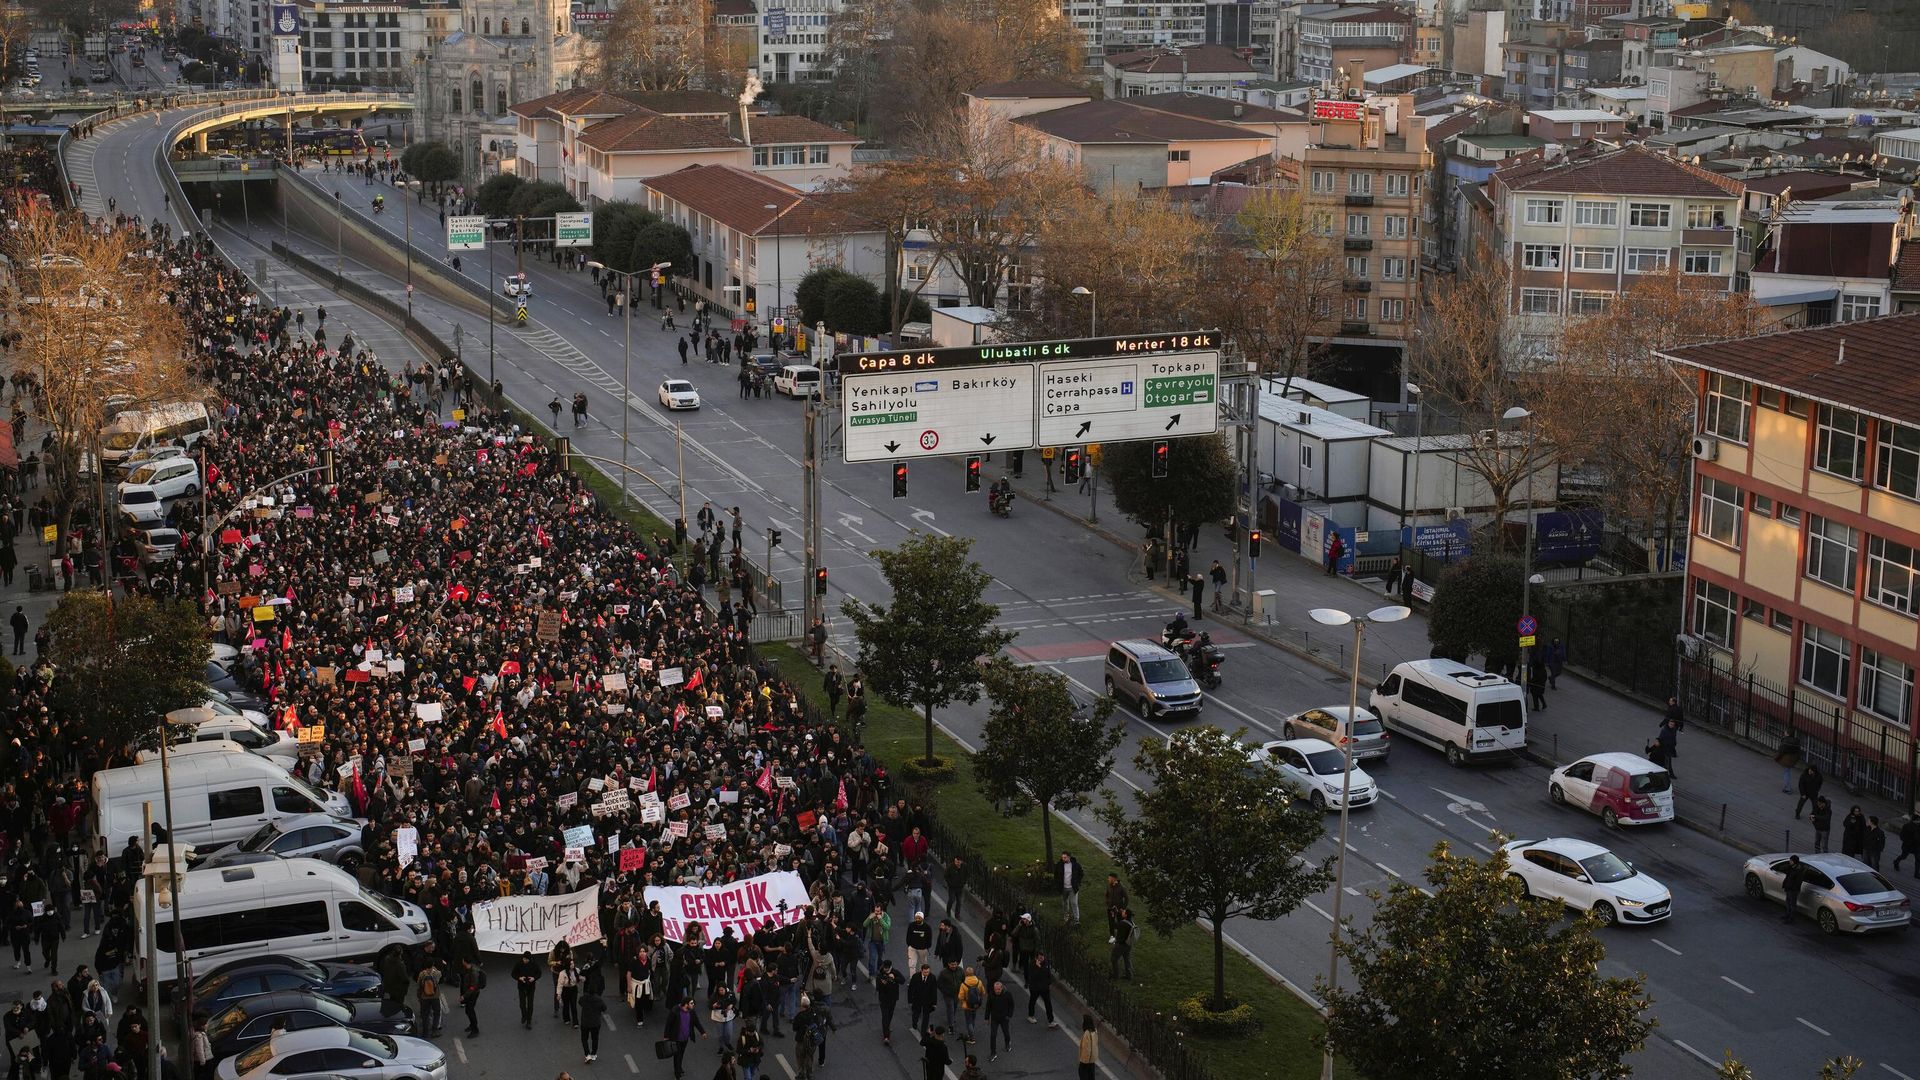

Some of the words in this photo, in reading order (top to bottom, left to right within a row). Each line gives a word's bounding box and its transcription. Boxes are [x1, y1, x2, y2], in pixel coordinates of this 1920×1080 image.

[1317, 107, 1360, 119] HOTEL
[1116, 338, 1165, 352] Merter
[1171, 337, 1188, 348] 18
[1193, 335, 1211, 346] dk
[981, 346, 1037, 359] Ulubatlı
[1041, 345, 1050, 355] 6
[1054, 344, 1071, 354] dk
[859, 357, 897, 370] Çapa
[902, 354, 911, 366] 8
[917, 353, 935, 364] dk
[1152, 362, 1205, 375] Topkapı
[952, 377, 1017, 390] Bakırköy
[1047, 373, 1093, 385] Haseki
[1145, 376, 1214, 391] Çevreyolu
[852, 385, 913, 397] Yenikapı
[1047, 386, 1118, 400] Cerrahpaşa
[851, 398, 917, 412] Sahilyolu
[1145, 393, 1191, 404] Otogar
[1047, 403, 1080, 414] Çapa
[851, 415, 886, 425] Avrasya
[888, 411, 916, 422] Tüneli
[680, 881, 773, 919] GENÇLİK
[487, 900, 584, 933] HÜKÜMET
[662, 918, 712, 946] BİT
